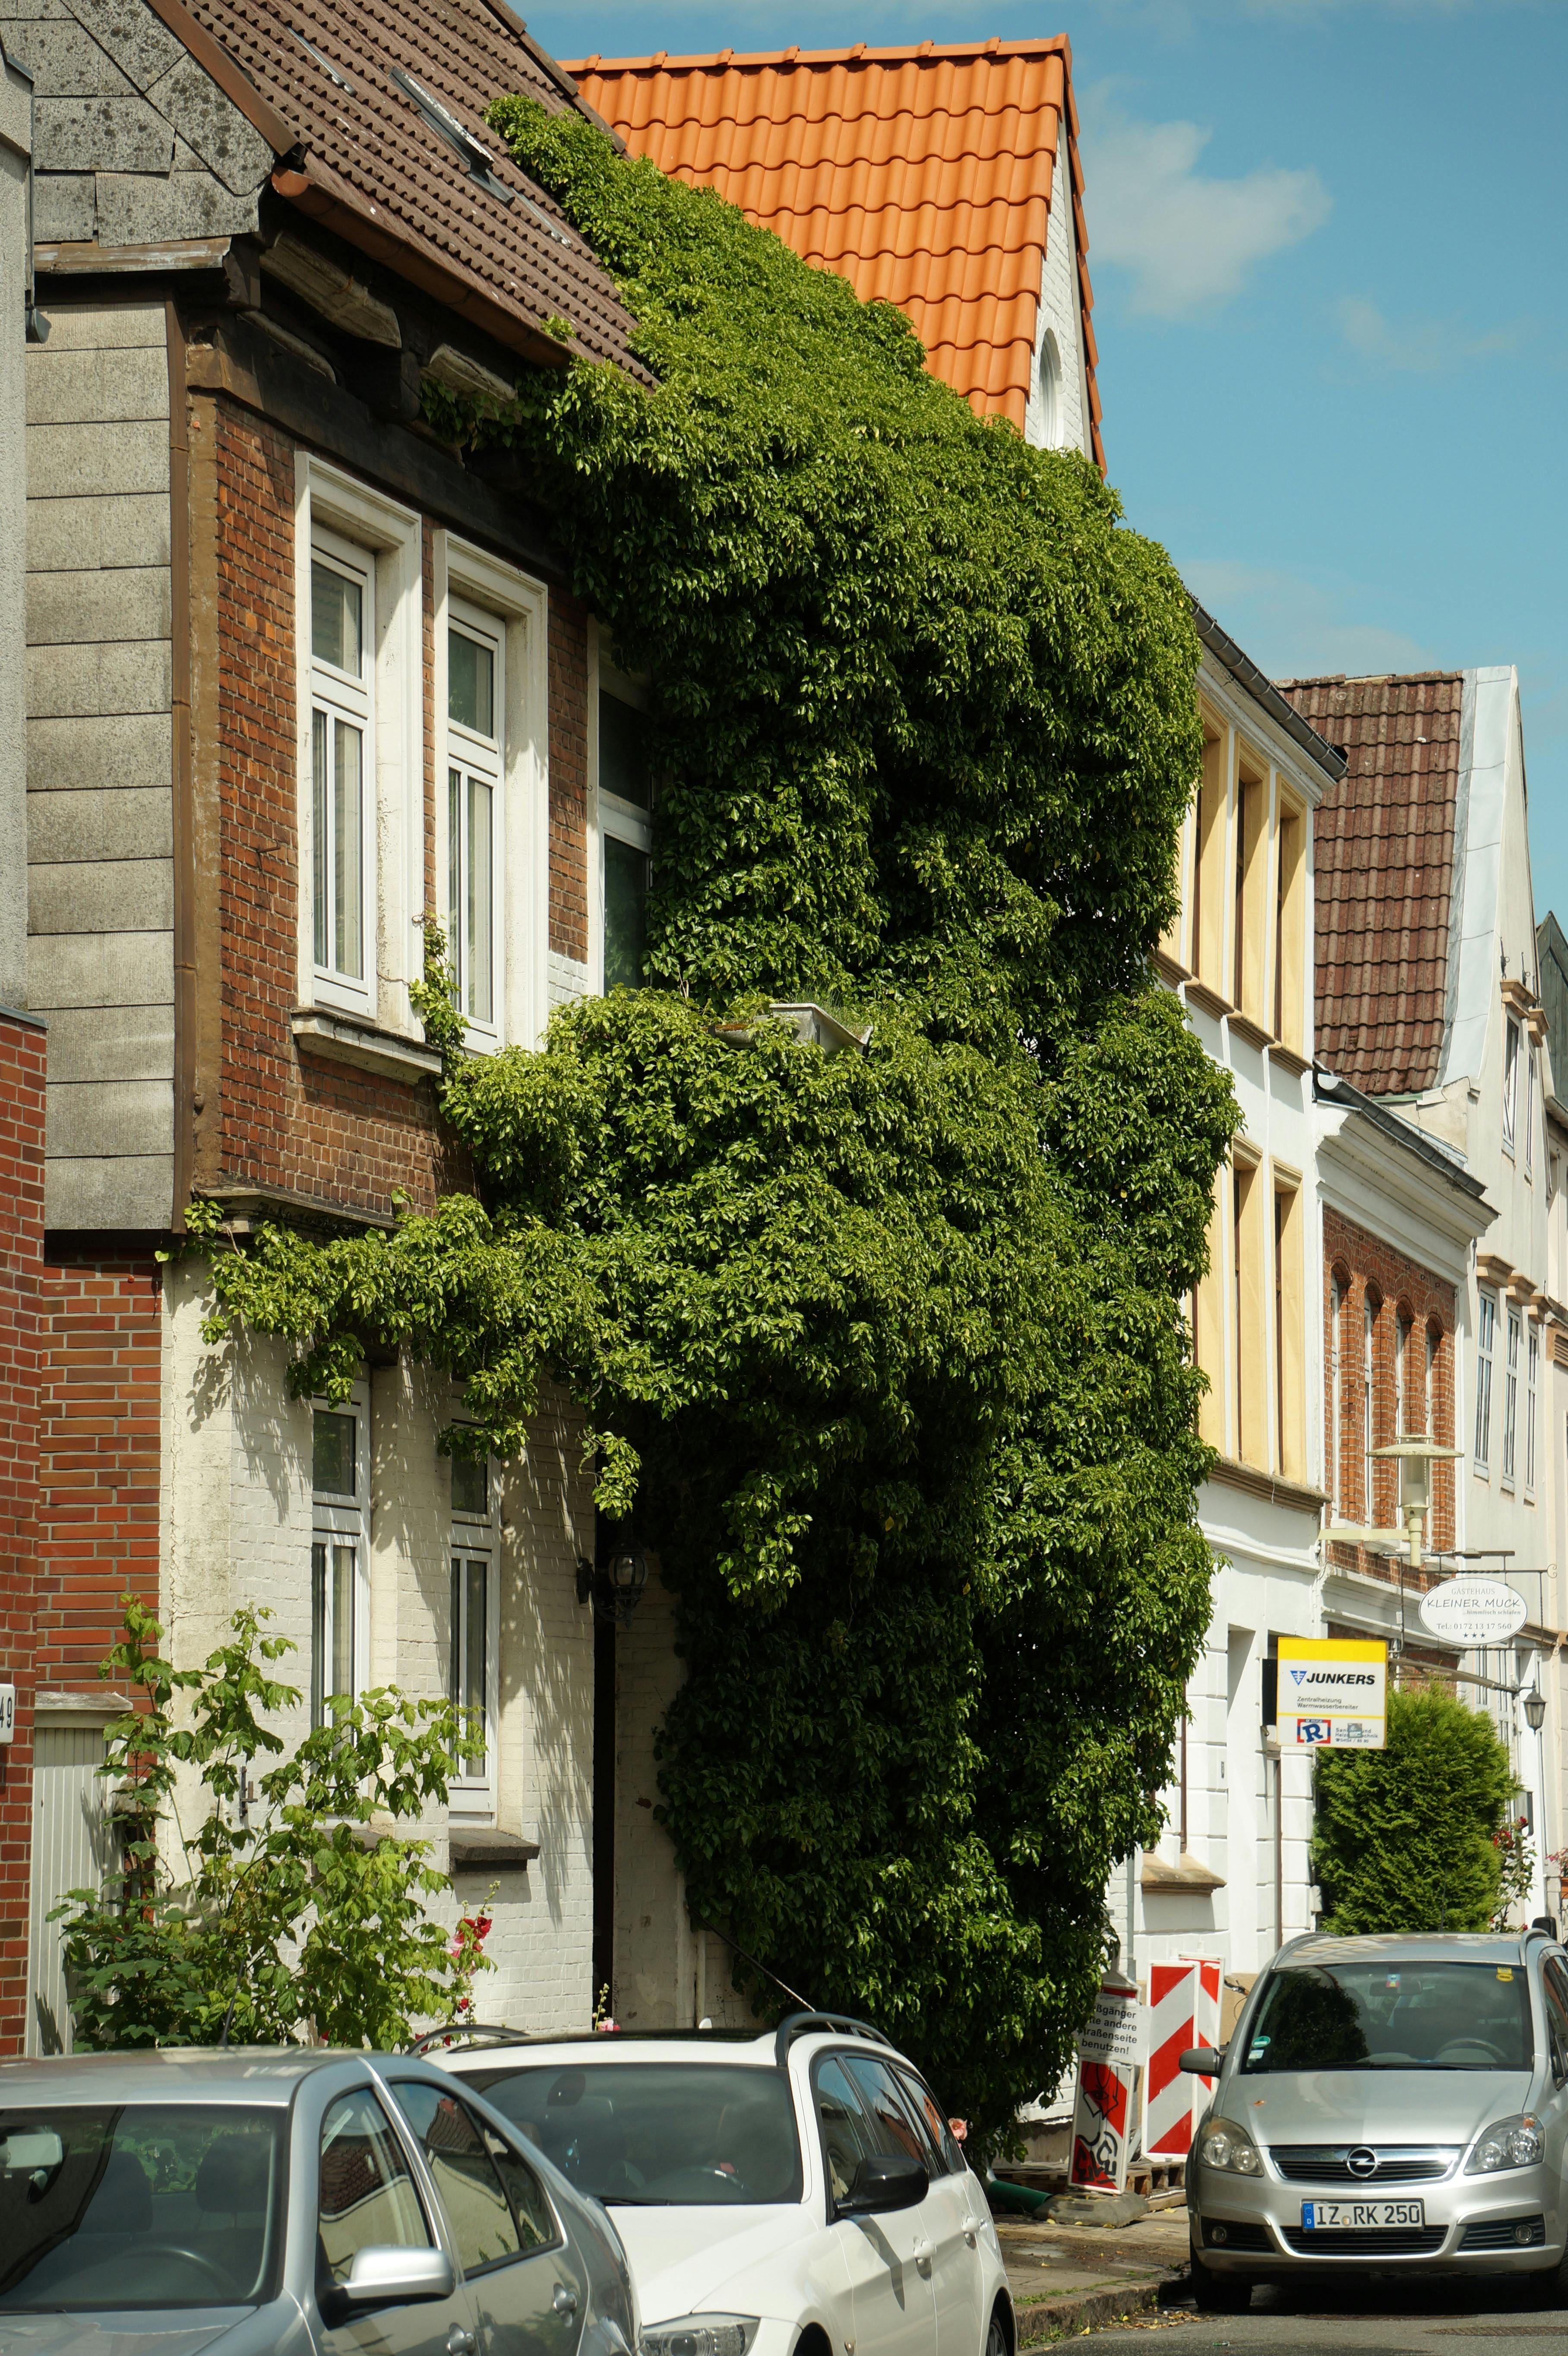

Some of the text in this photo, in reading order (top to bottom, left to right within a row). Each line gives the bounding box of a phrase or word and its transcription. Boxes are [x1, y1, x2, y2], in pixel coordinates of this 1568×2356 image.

[1427, 1599, 1520, 1608] KLEINER MUCK
[1306, 1673, 1375, 1685] JUNKERS
[0, 1697, 12, 1729] 49
[1302, 1724, 1324, 1743] R
[1097, 2004, 1136, 2019] ßgänger
[1104, 2020, 1137, 2031] andere
[1084, 2028, 1137, 2044] raßenseite
[1081, 2038, 1129, 2055] benutzen!
[1317, 2205, 1419, 2225] IZ RK 250
